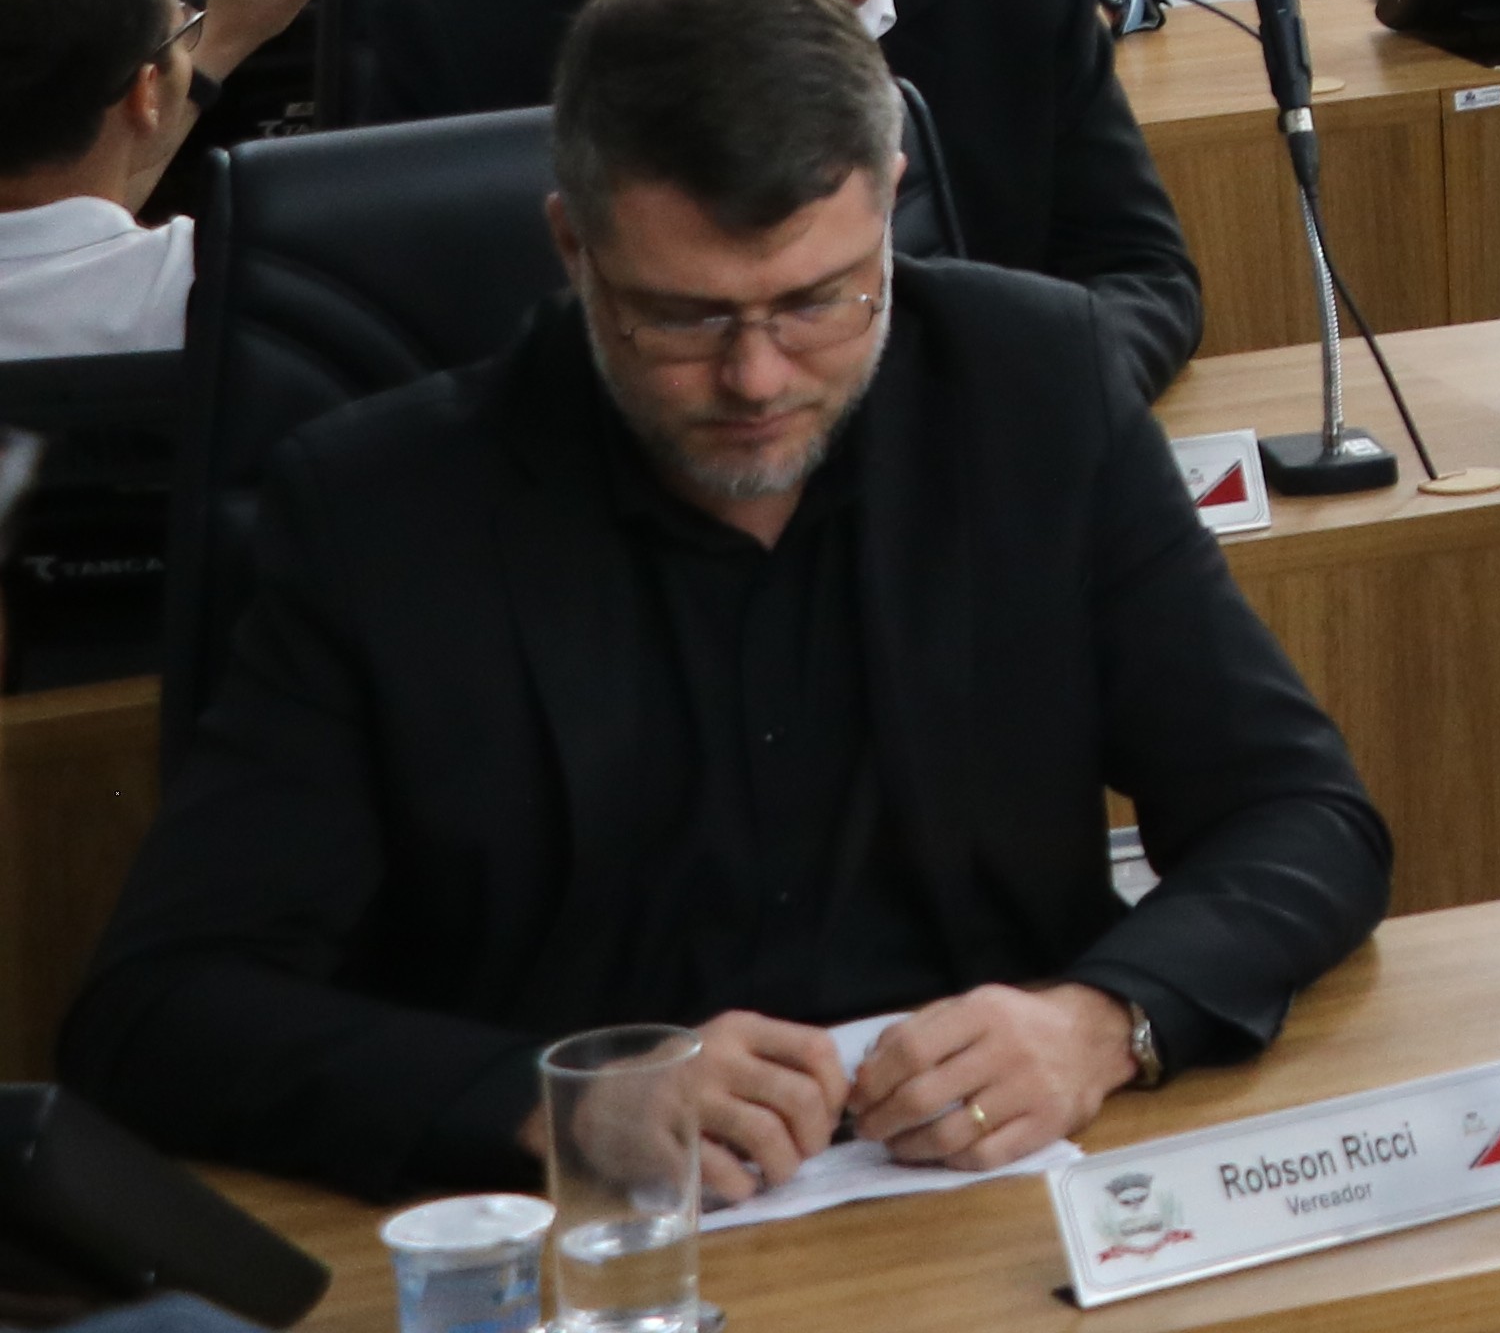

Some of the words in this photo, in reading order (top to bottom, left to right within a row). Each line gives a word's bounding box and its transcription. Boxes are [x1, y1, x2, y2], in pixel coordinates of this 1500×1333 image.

[1219, 1144, 1338, 1201] Robson
[1341, 1122, 1420, 1184] Ricci
[1284, 1179, 1375, 1220] Vereador
